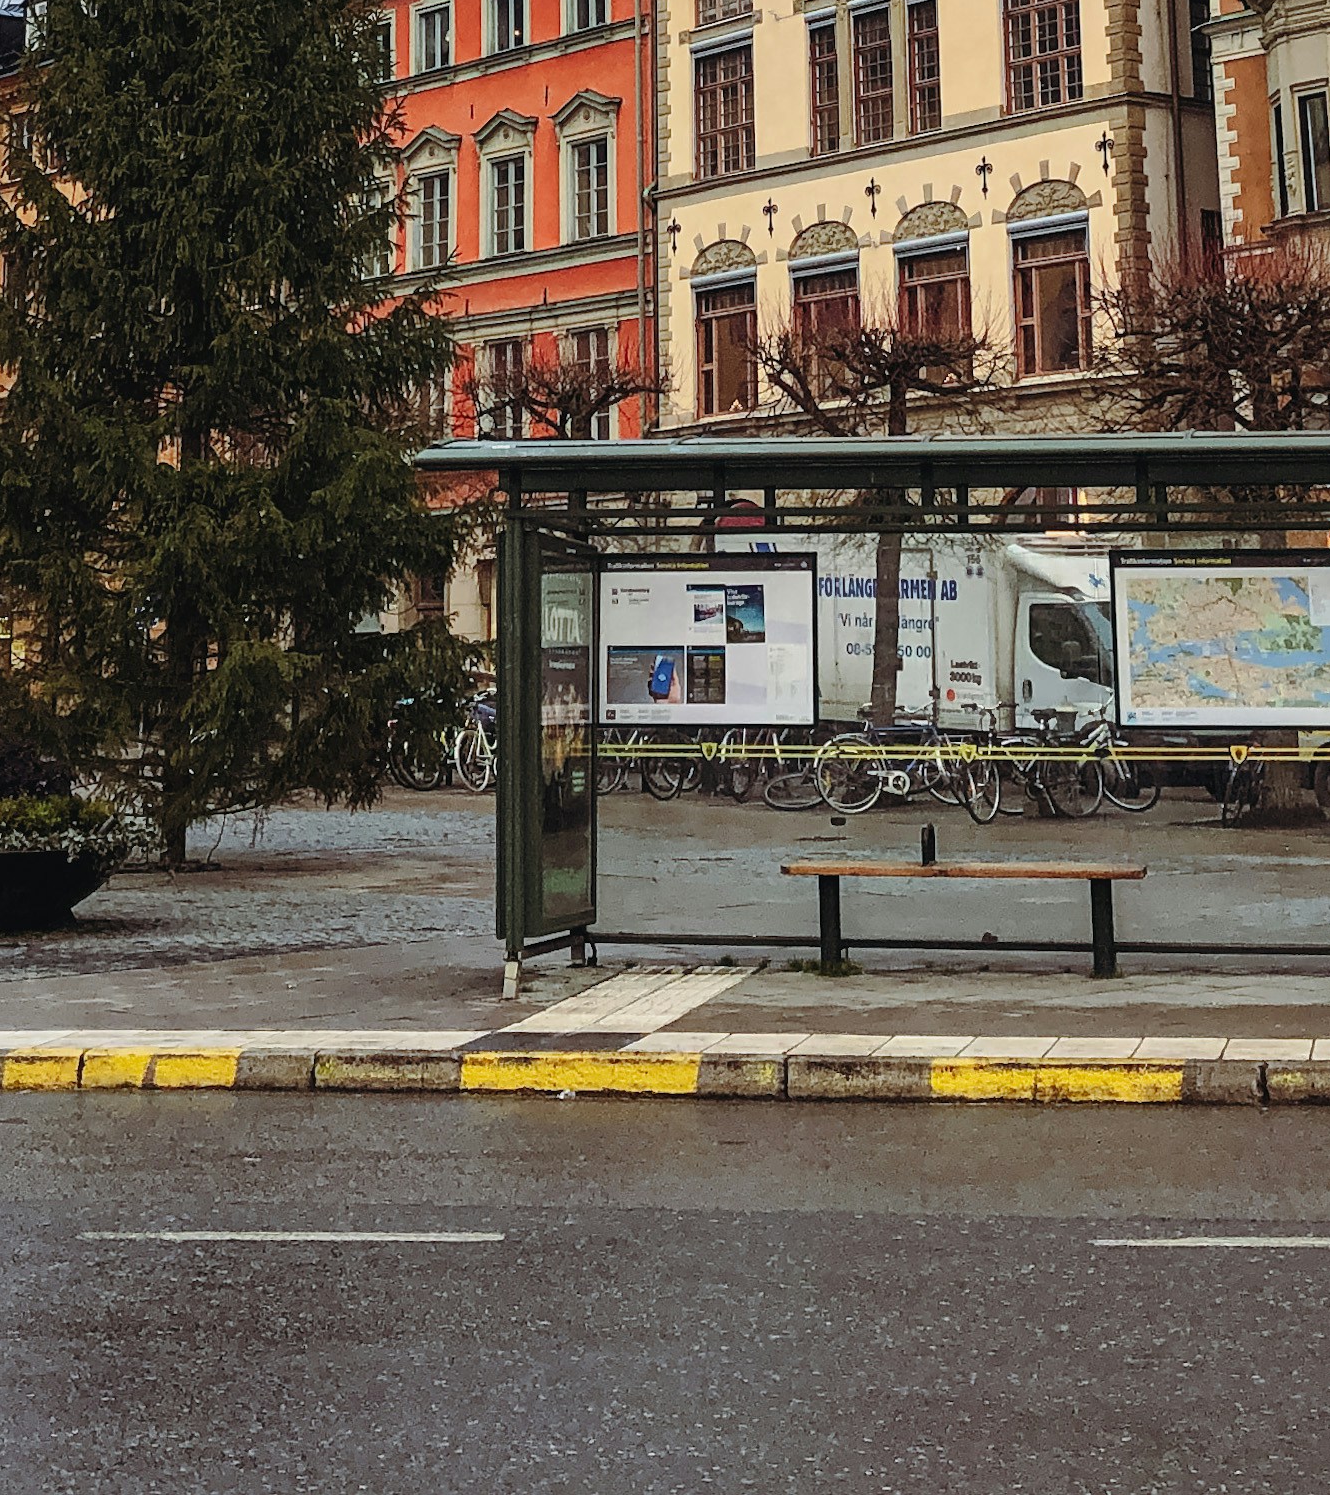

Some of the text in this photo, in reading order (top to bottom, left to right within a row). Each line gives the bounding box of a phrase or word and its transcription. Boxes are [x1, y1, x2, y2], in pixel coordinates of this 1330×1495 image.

[818, 573, 958, 601] FÖRLÄNG RMEN AB
[855, 611, 874, 628] når
[916, 645, 932, 659] 00
